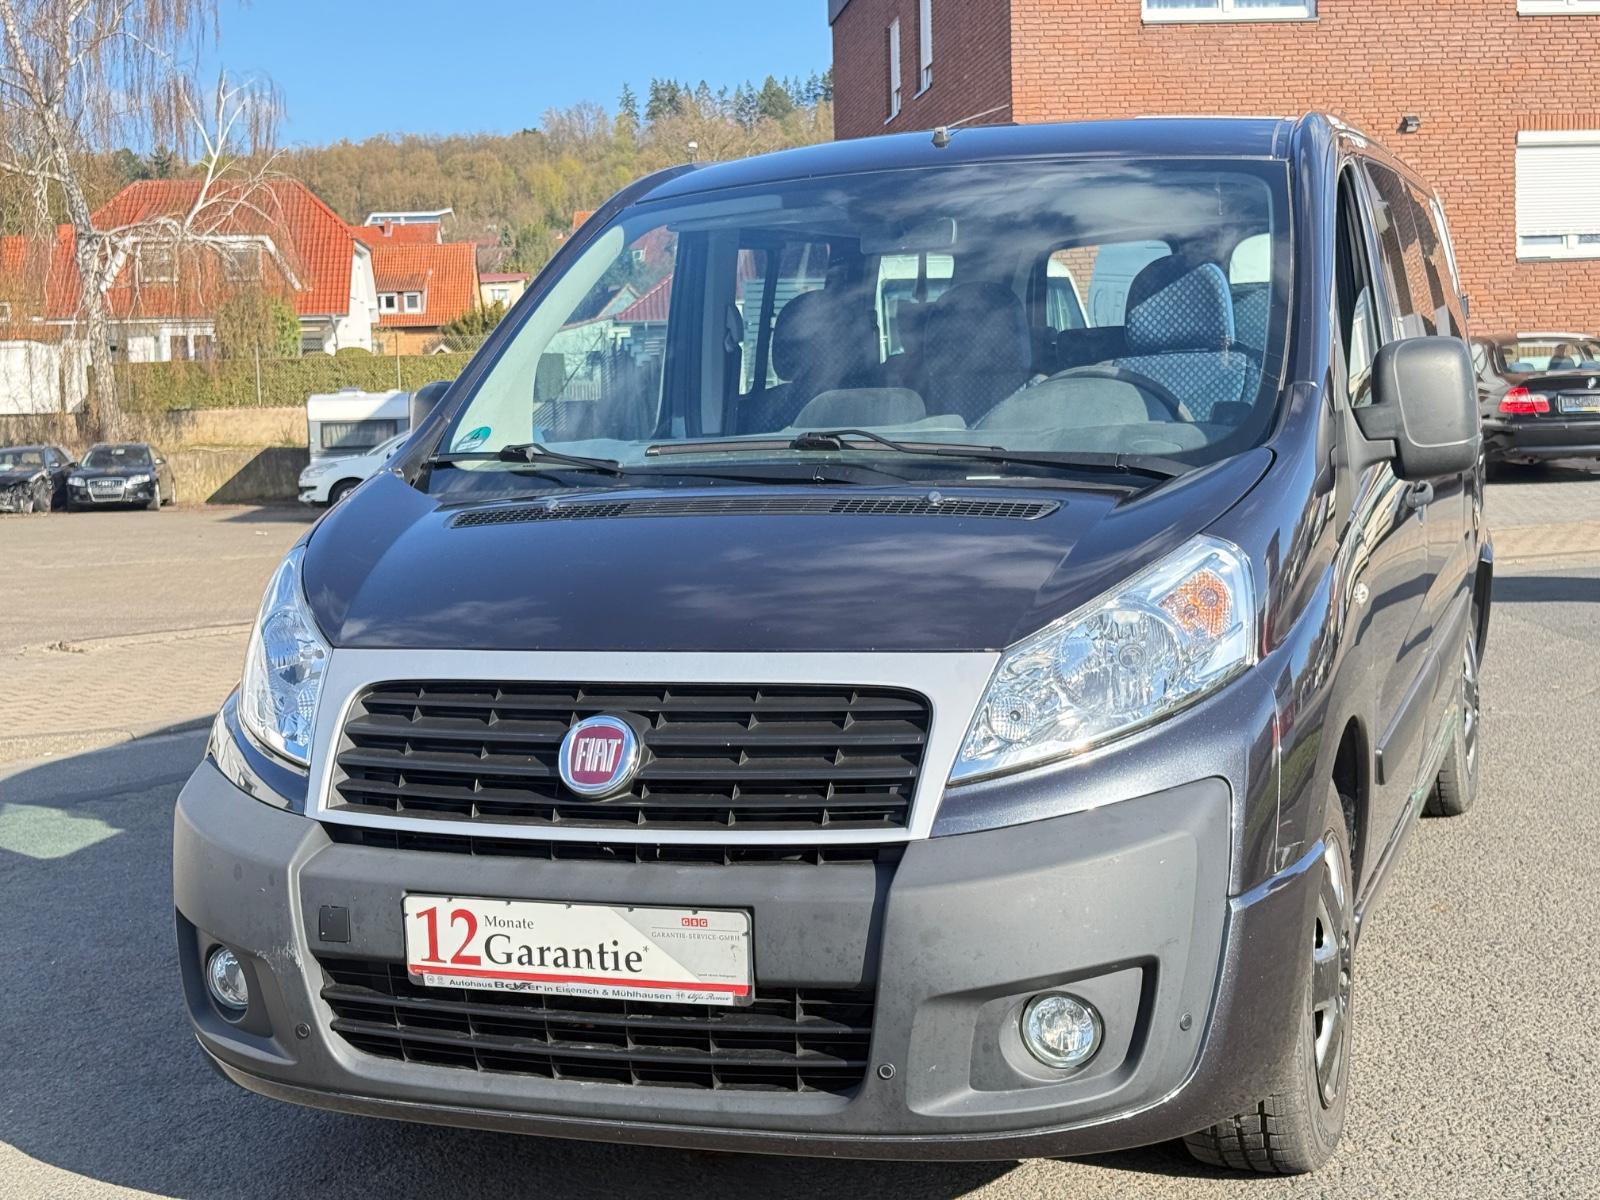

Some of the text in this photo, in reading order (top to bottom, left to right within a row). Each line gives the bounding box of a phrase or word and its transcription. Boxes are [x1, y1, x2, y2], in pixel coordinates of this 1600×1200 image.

[575, 737, 621, 772] FIAT
[416, 906, 482, 966] 12
[484, 915, 534, 929] Monate
[449, 979, 493, 988] Autohaus
[555, 986, 599, 995] Eisenach
[612, 989, 672, 1000] Mühlhausen
